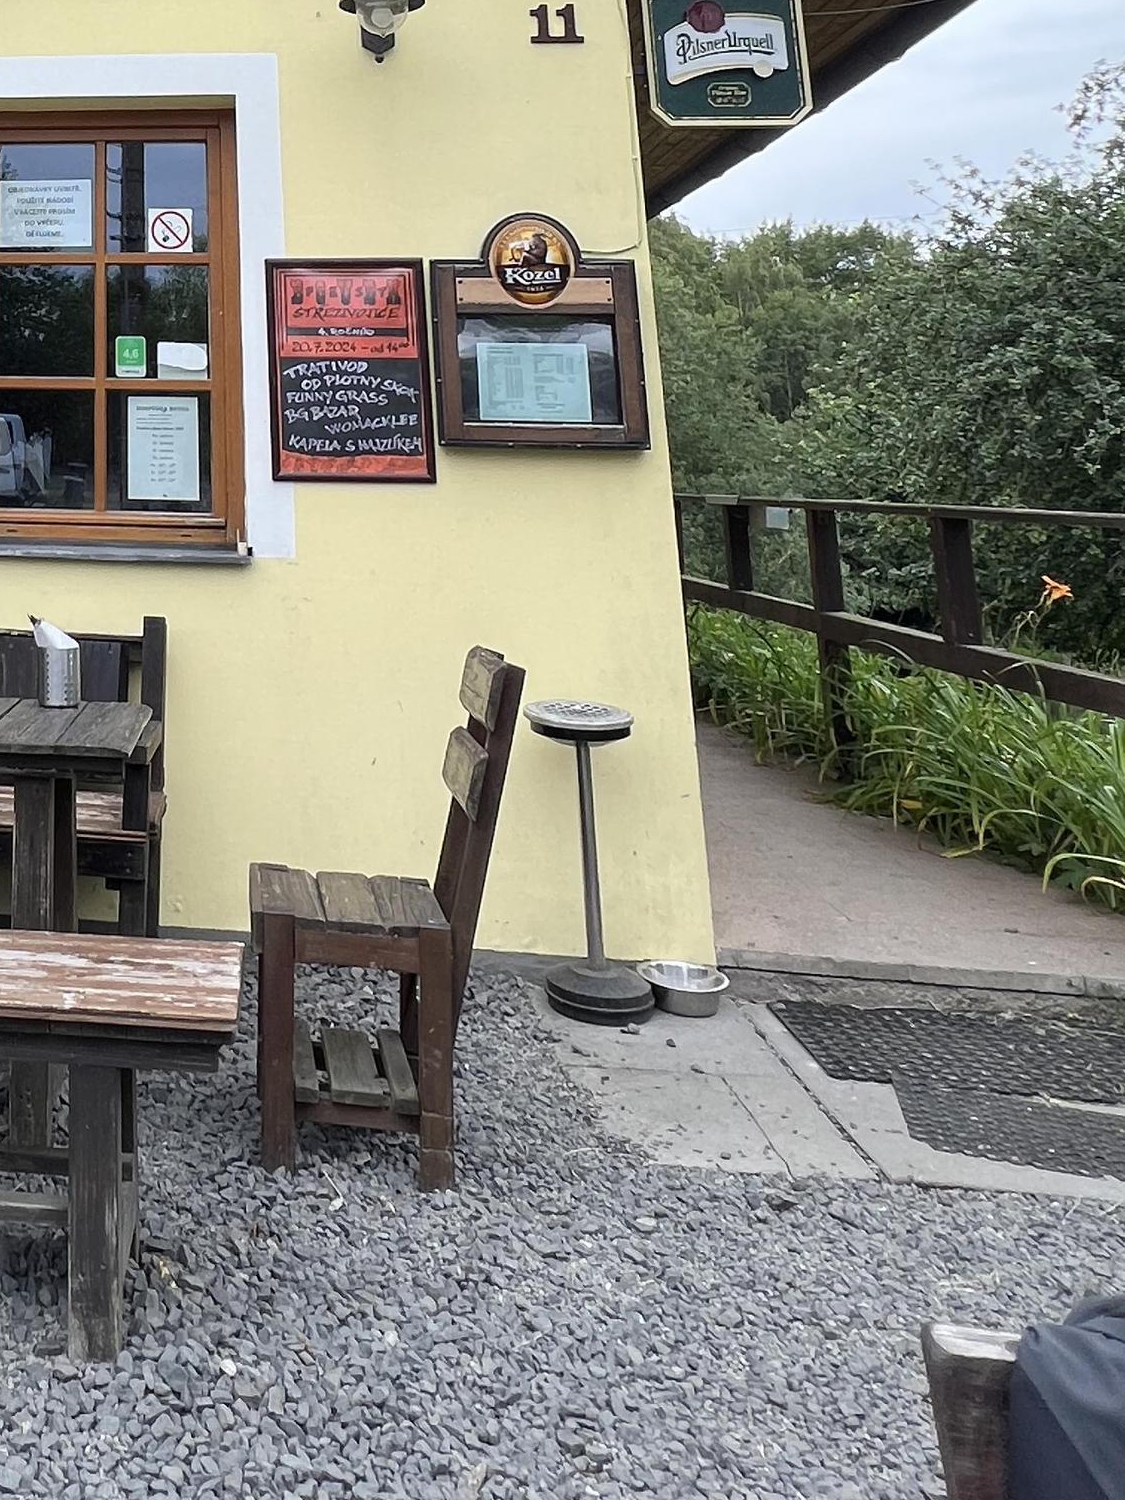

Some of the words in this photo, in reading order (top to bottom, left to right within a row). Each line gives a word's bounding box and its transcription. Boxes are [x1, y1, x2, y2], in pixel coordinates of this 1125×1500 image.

[529, 3, 585, 44] 11
[676, 33, 728, 65] Pilsner
[725, 29, 774, 56] Urquell
[504, 267, 562, 285] Kozel
[283, 361, 368, 379] TRATIVOD
[301, 379, 322, 391] OD
[323, 374, 381, 389] PLOTNY
[286, 390, 333, 404] FUNNY
[335, 390, 389, 406] GRASS
[284, 408, 309, 424] BG
[309, 405, 362, 421] BAZAR
[289, 434, 341, 452] KAPELA
[345, 440, 356, 451] S
